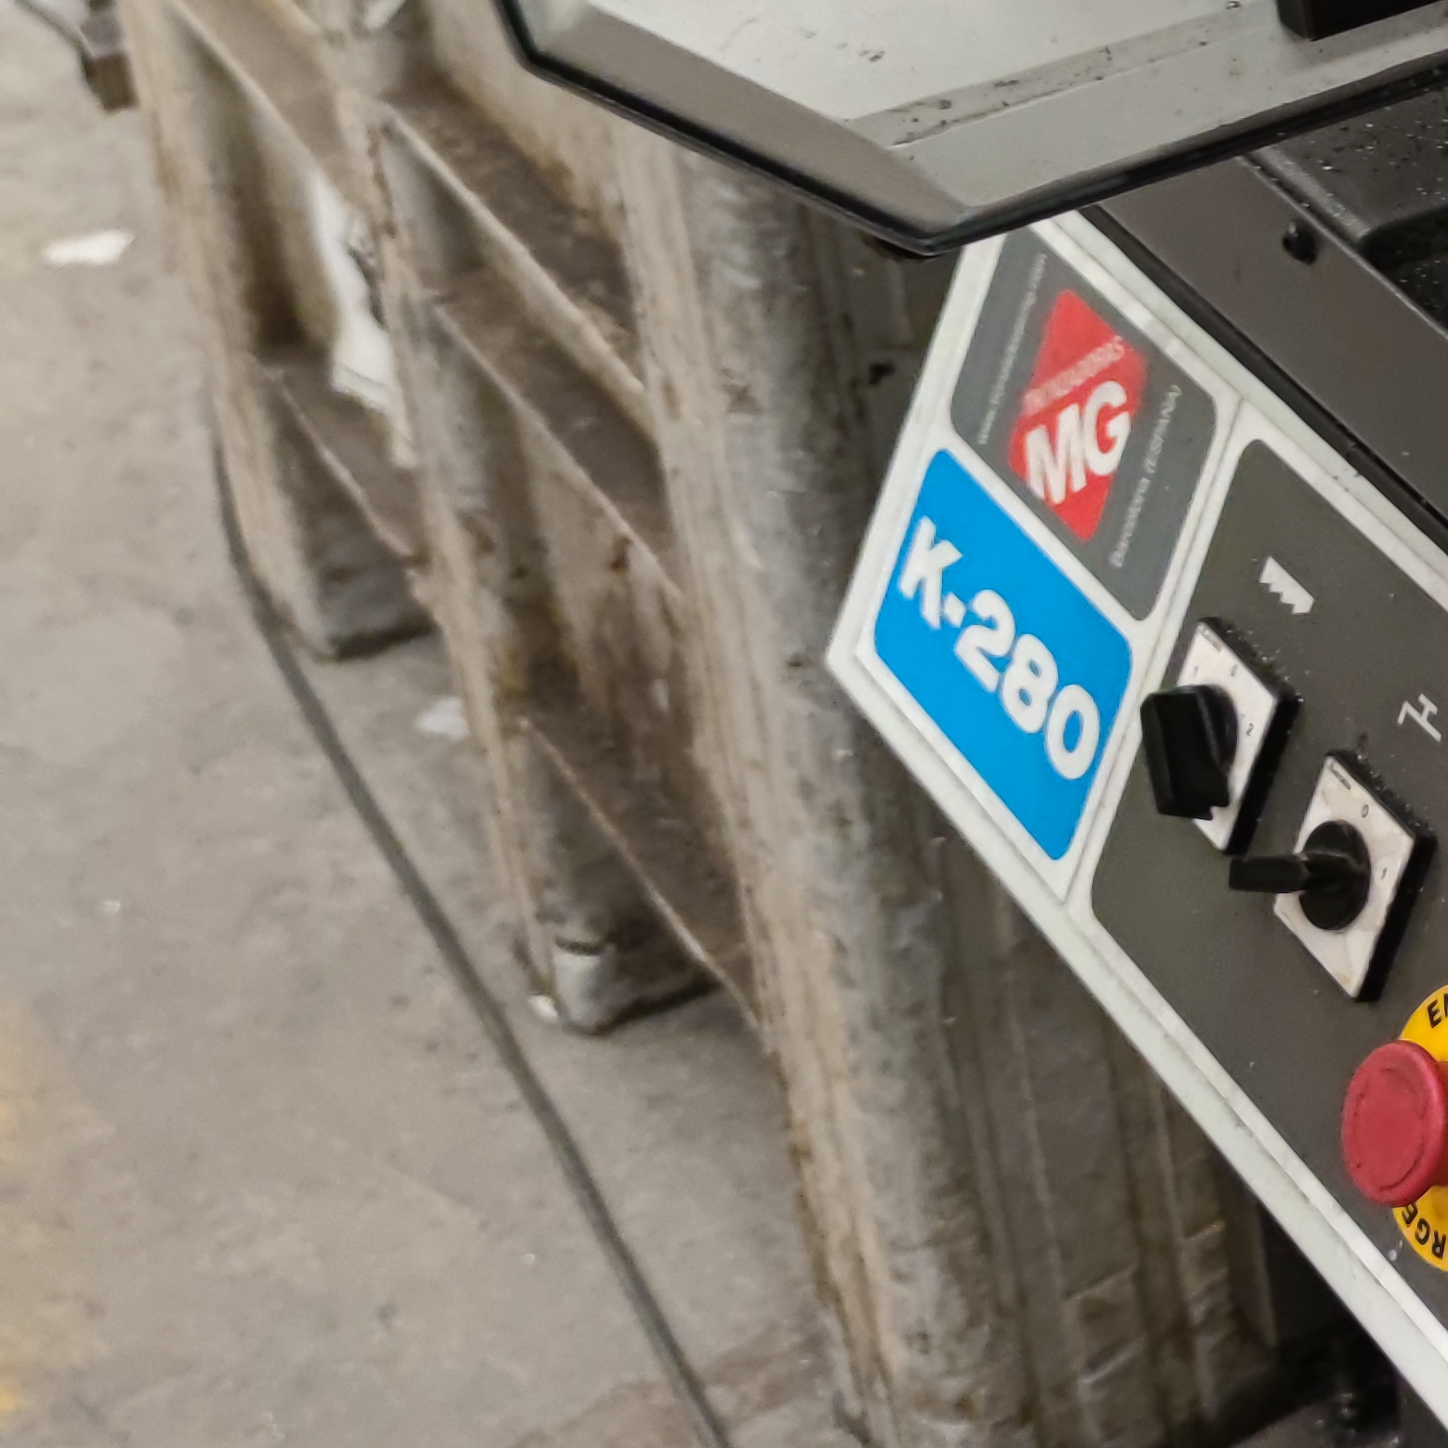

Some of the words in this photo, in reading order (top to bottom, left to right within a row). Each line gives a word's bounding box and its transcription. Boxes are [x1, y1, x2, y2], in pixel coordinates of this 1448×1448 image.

[1026, 381, 1130, 504] MG
[897, 519, 1101, 781] K-280
[1361, 803, 1370, 818] 0
